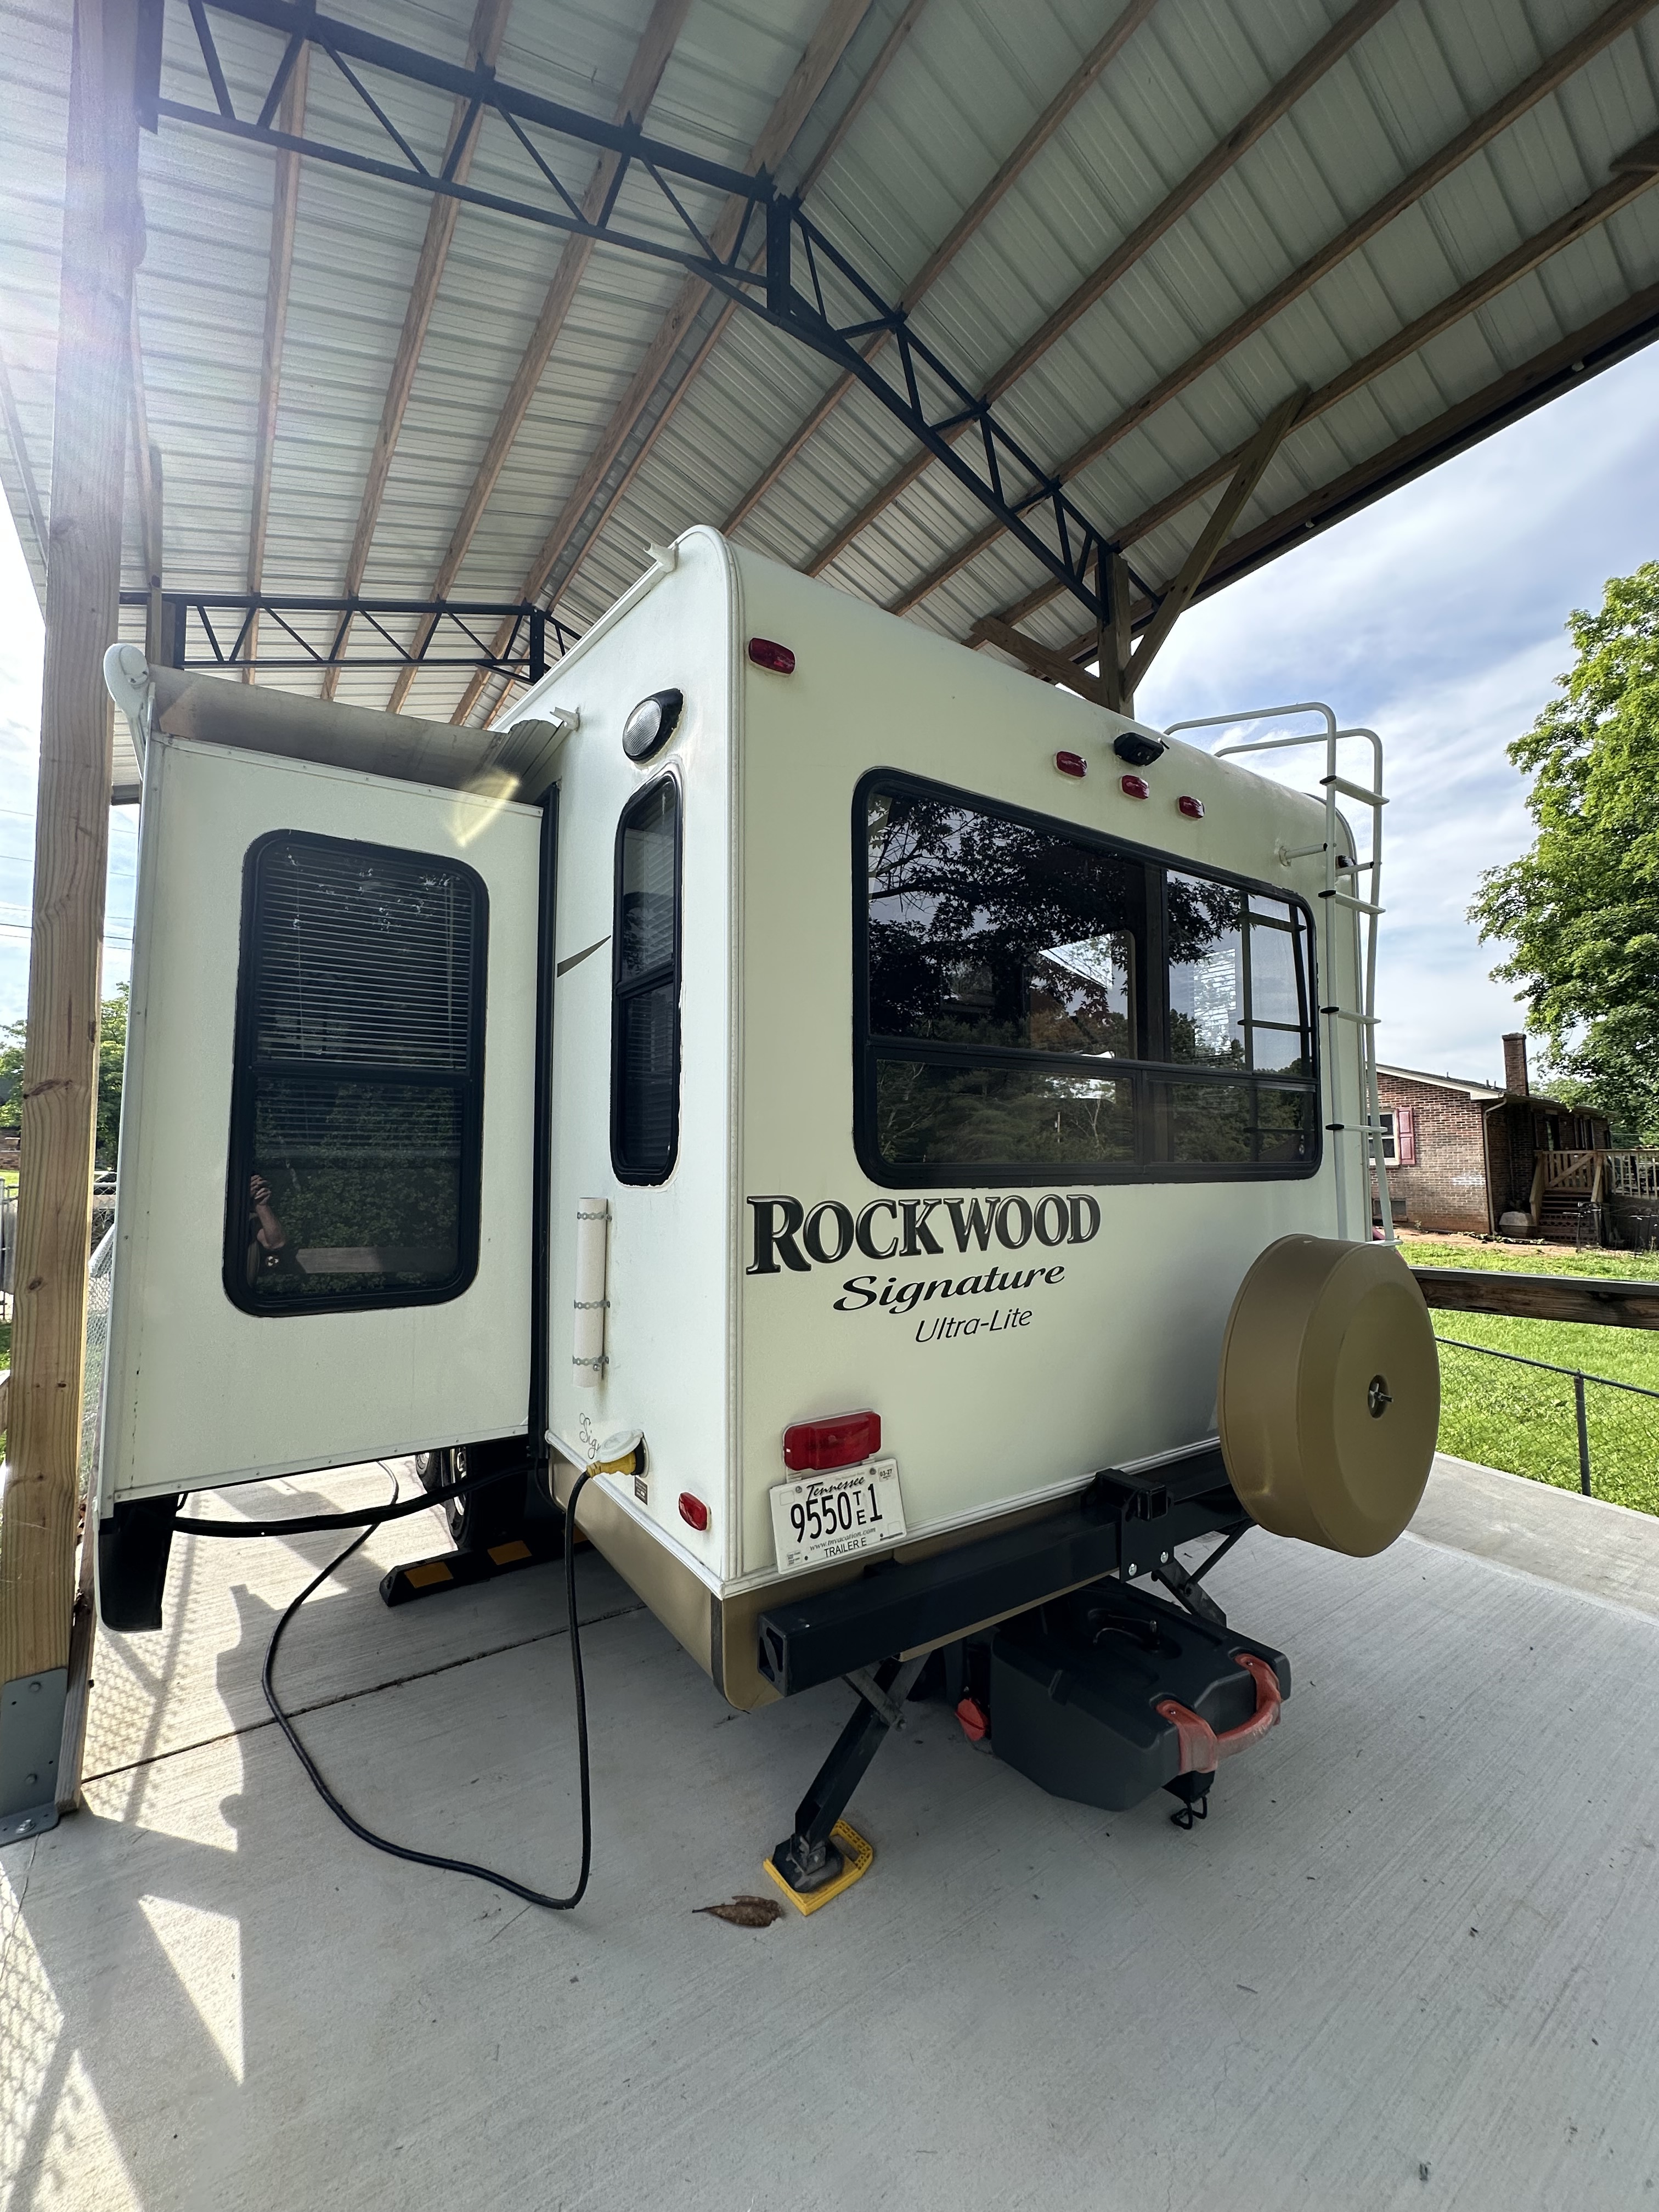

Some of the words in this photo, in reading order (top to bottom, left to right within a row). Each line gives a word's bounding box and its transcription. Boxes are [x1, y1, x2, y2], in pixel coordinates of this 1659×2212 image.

[746, 1194, 1101, 1275] ROCKWOOD
[833, 1265, 1065, 1314] Signature
[915, 1307, 1032, 1342] Ultra-Lite
[806, 1476, 865, 1502] Tennessee
[809, 1527, 876, 1551] www.tnvacation.com
[824, 1539, 860, 1558] TRAILER
[860, 1537, 867, 1547] E
